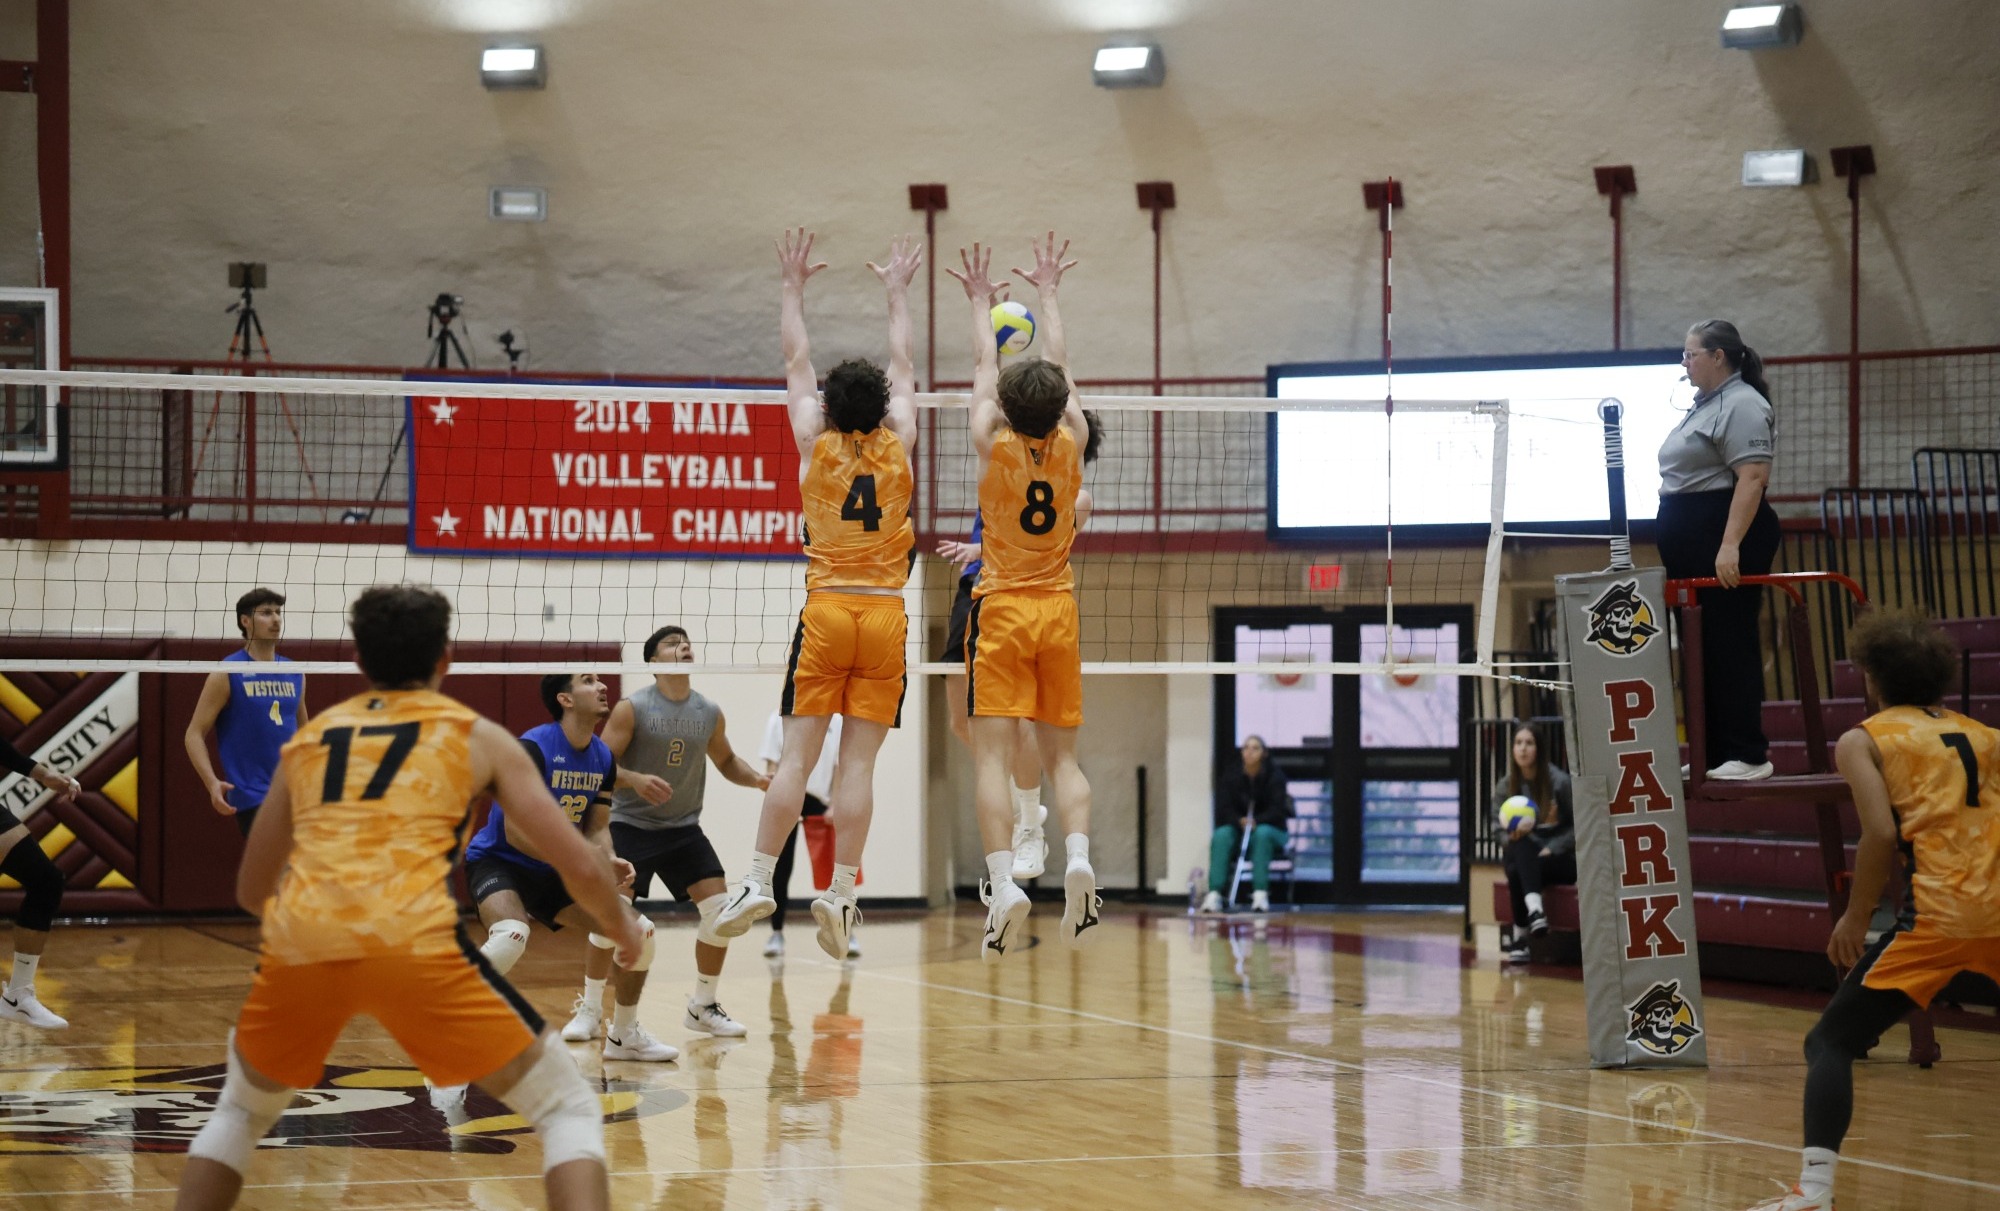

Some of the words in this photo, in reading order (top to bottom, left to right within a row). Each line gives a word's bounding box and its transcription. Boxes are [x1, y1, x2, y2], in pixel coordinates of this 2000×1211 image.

[574, 400, 651, 434] 2014
[672, 402, 750, 435] NAIA
[552, 452, 776, 490] VOLLEYBALL
[841, 474, 882, 532] 4
[1019, 480, 1057, 535] 8
[483, 505, 653, 542] NATIONAL
[269, 699, 284, 726] 4
[320, 721, 421, 804] 17
[667, 737, 685, 767] 2
[1940, 732, 1981, 808] 1
[551, 769, 604, 792] WESTCLIFF
[1603, 678, 1687, 961] PARK
